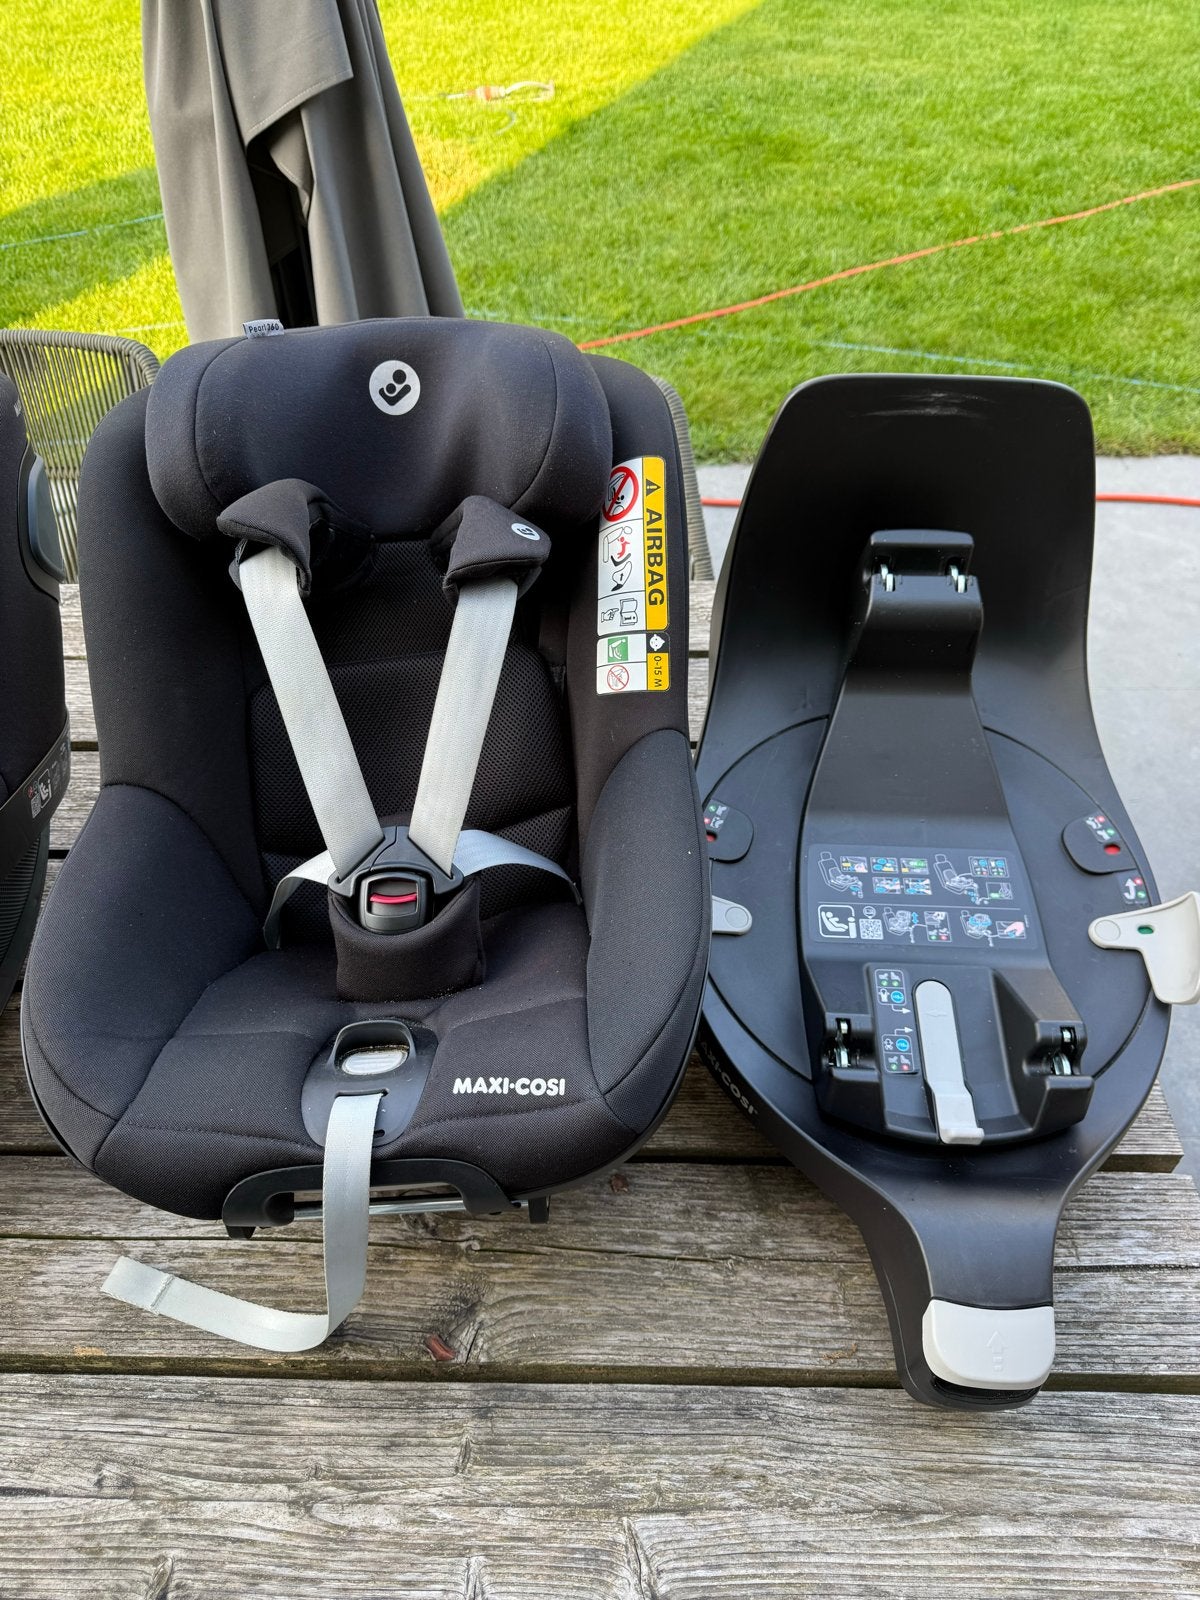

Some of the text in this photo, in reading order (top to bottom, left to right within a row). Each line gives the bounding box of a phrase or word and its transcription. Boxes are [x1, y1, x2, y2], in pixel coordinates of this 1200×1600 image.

[646, 508, 664, 606] AIRBAG
[653, 655, 662, 688] 0-15 M
